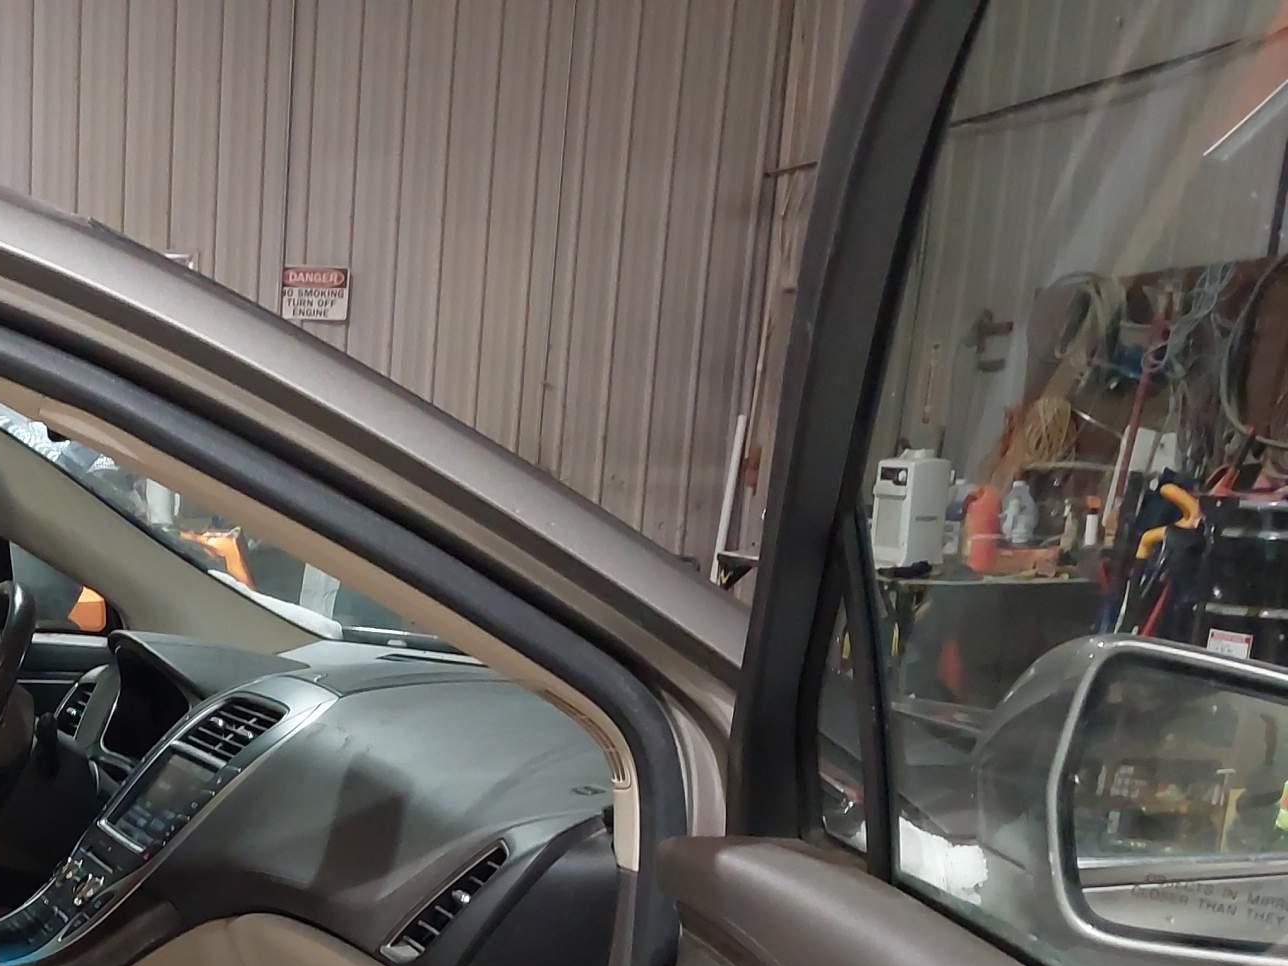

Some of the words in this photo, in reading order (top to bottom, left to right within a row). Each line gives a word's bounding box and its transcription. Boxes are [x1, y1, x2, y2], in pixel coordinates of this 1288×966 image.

[288, 271, 339, 283] DANGER
[298, 288, 344, 299] SMOKING
[287, 298, 313, 307] TURN
[317, 299, 337, 308] OFF
[292, 308, 329, 318] ENGINE
[1198, 898, 1238, 916] THAN
